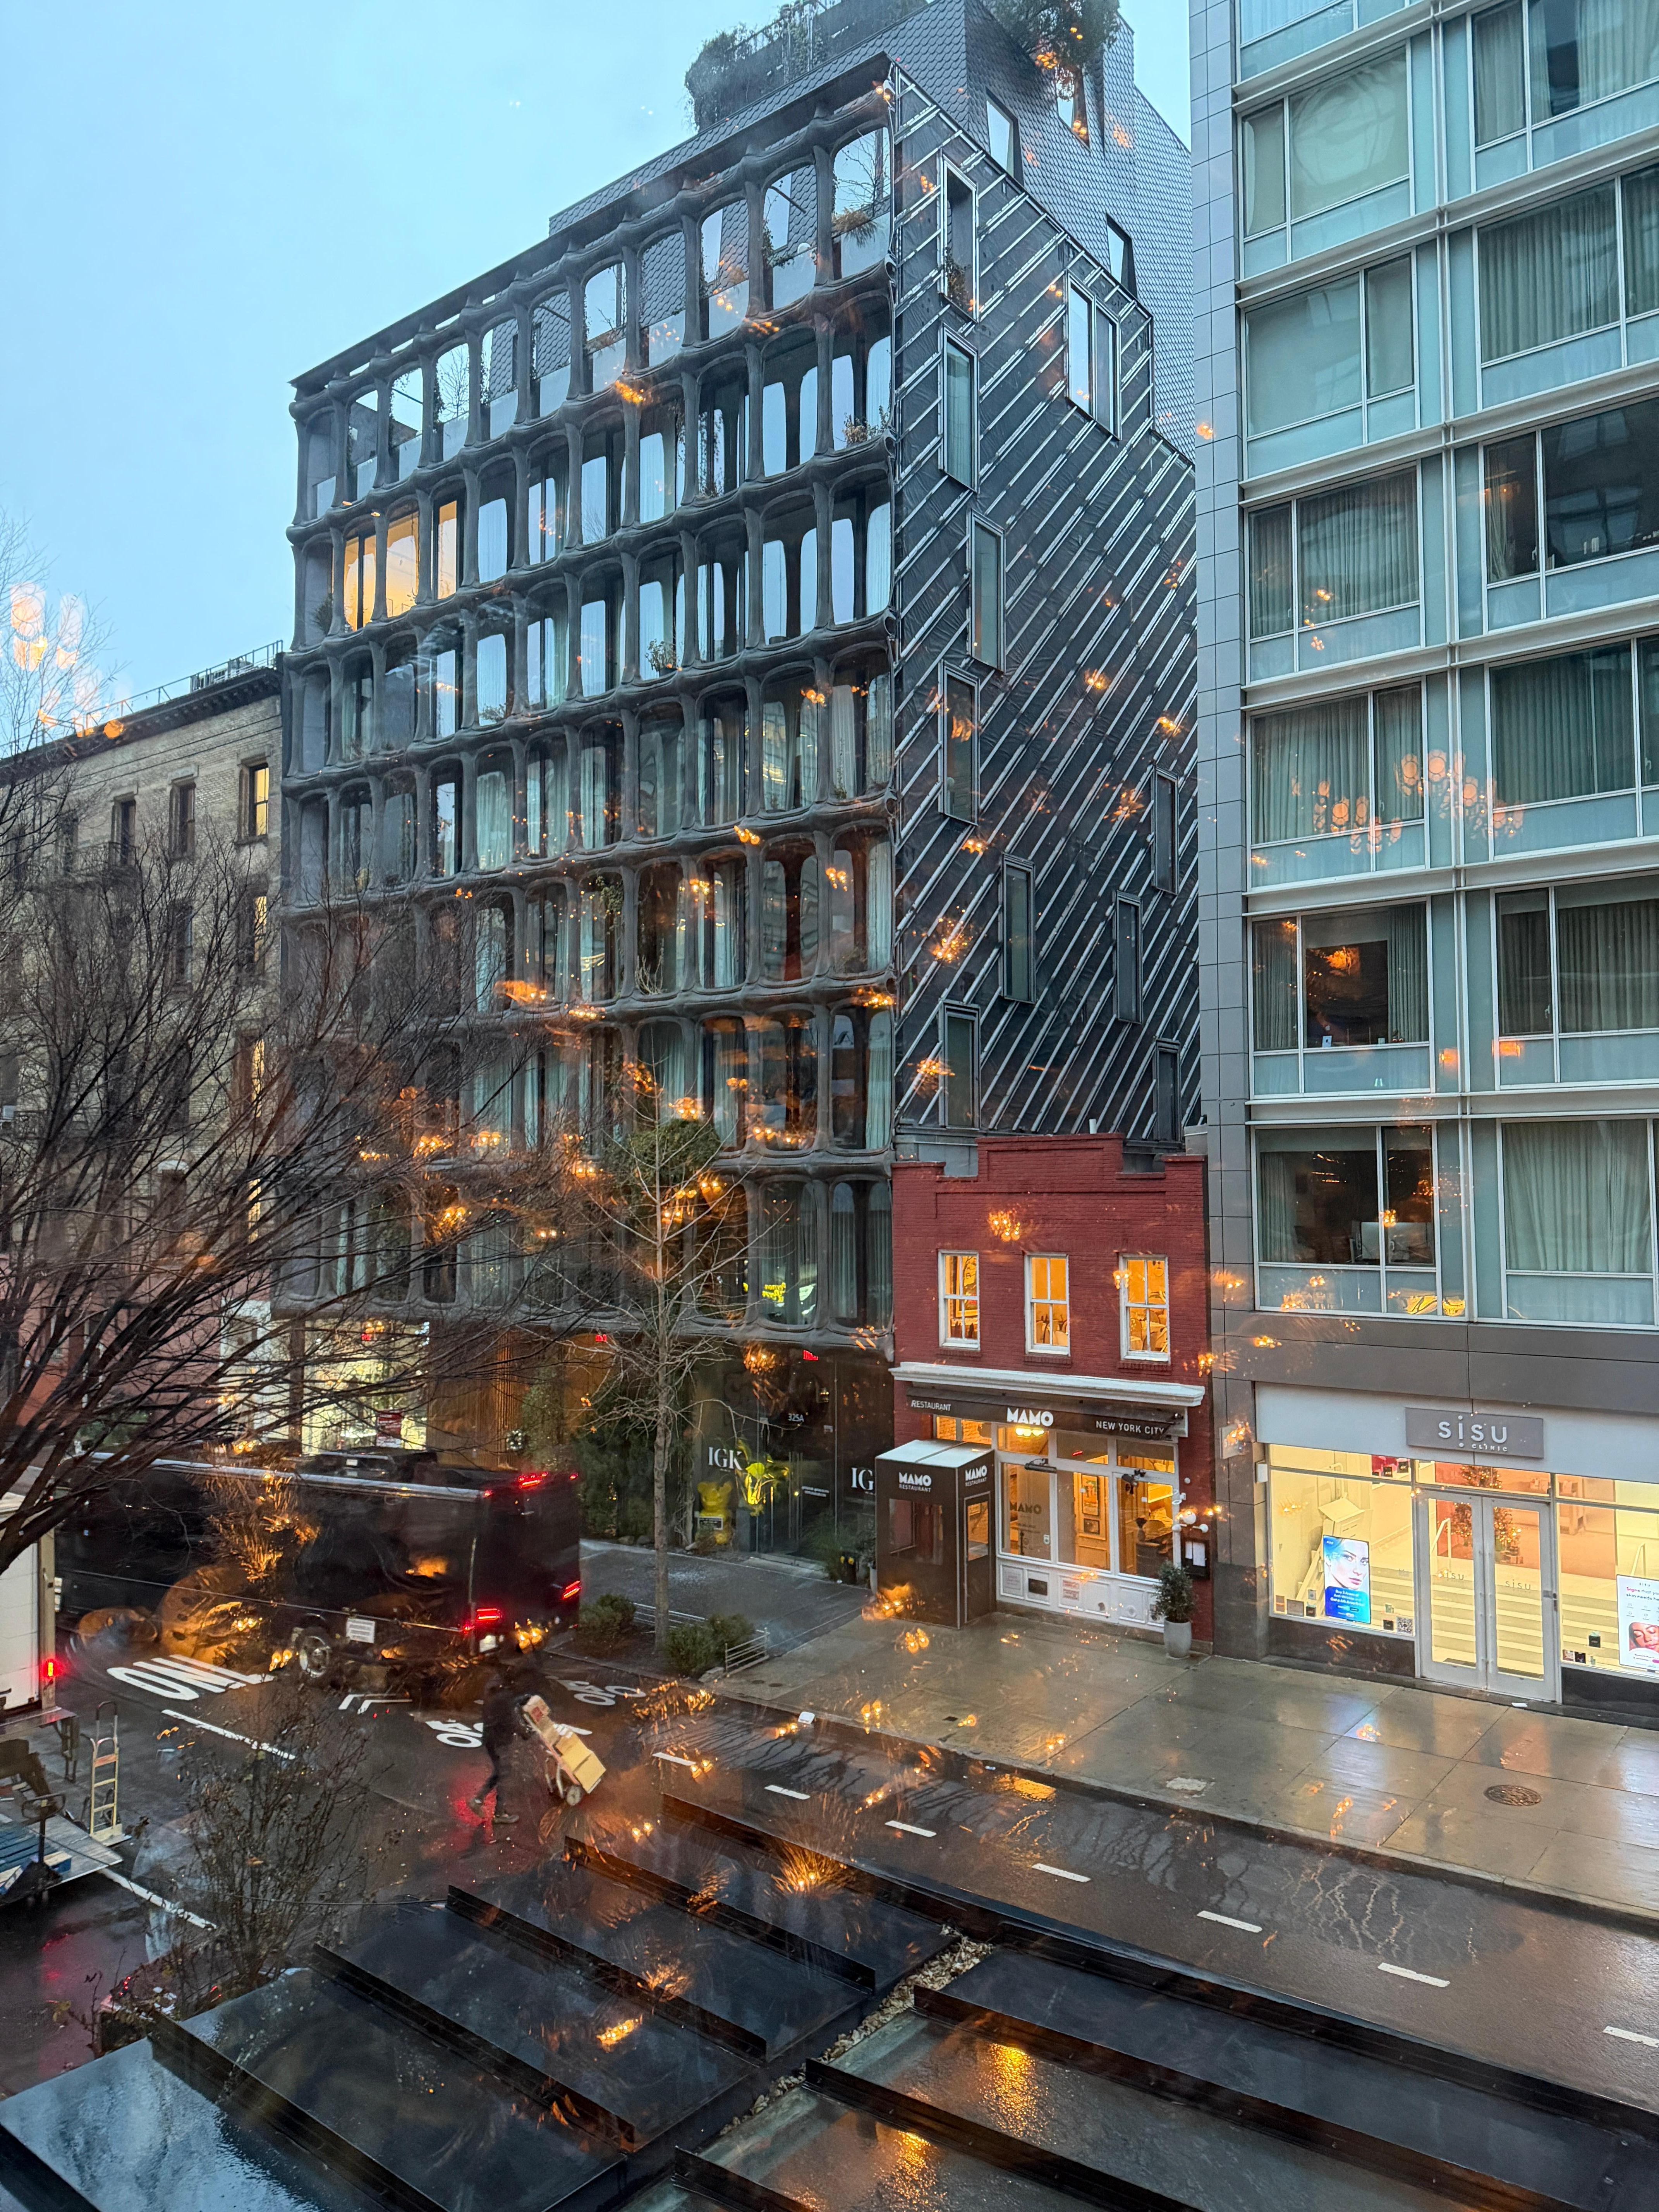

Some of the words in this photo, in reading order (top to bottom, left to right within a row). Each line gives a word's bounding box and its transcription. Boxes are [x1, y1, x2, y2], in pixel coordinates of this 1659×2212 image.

[911, 1400, 952, 1412] RESTAURANT
[1006, 1407, 1054, 1427] MAMO
[1096, 1420, 1115, 1431] NEW
[1118, 1422, 1141, 1434] YORK
[1144, 1424, 1165, 1436] CITY
[1471, 1443, 1508, 1452] CLINIC
[708, 1447, 743, 1471] IGK
[851, 1467, 874, 1491] IG
[899, 1472, 932, 1487] MAMO
[965, 1465, 988, 1481] MAMO
[899, 1484, 931, 1493] RESTAURANT
[965, 1477, 988, 1487] RESTAURANT
[1010, 1501, 1042, 1515] MAMO
[106, 1654, 275, 1701] ONL
